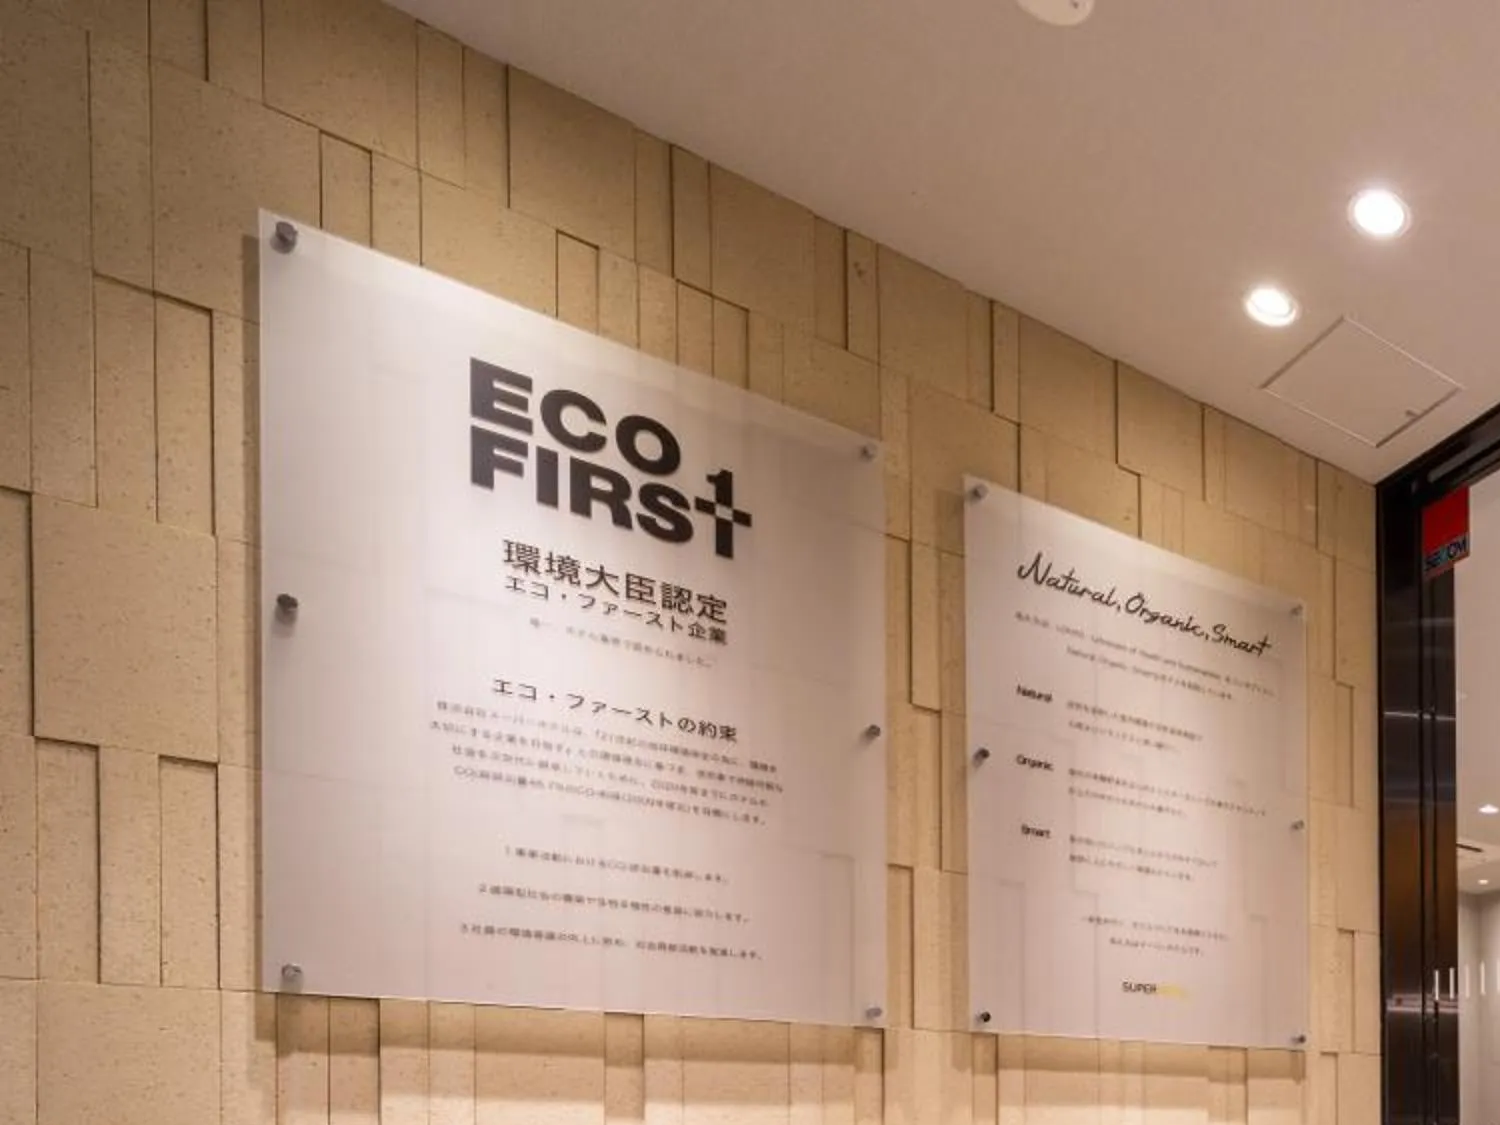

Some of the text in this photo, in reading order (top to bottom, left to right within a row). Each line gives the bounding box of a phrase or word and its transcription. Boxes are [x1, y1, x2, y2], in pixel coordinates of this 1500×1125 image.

[470, 357, 681, 478] ECO
[503, 540, 727, 624] 環境大臣認定
[505, 575, 728, 645] エコ・ファースト企業
[1212, 624, 1272, 657] Smart
[492, 678, 739, 743] エコ・ファーストの約束
